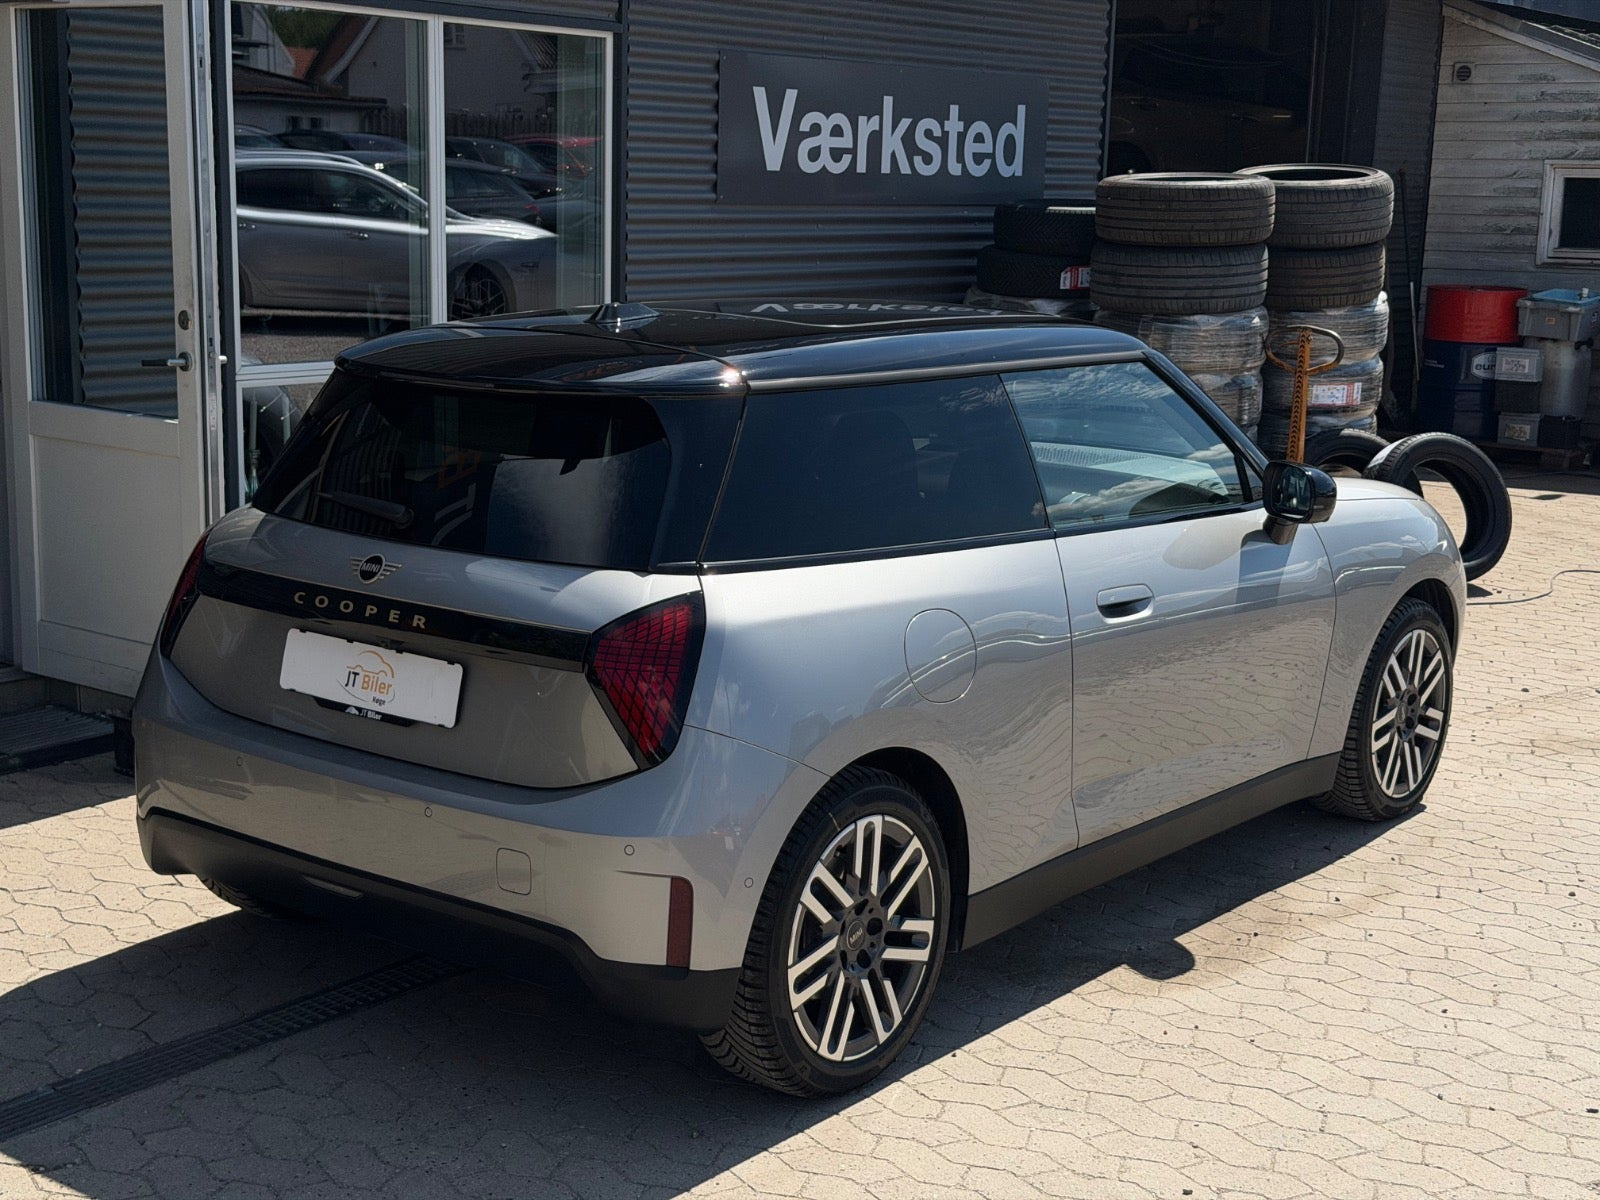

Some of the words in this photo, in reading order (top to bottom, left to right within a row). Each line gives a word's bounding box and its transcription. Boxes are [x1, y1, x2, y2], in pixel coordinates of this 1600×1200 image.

[752, 86, 1026, 178] Værksted
[361, 562, 381, 573] MINI
[294, 592, 426, 629] COOPER
[345, 670, 360, 688] JT
[361, 674, 393, 695] Biler
[367, 710, 383, 721] Biler
